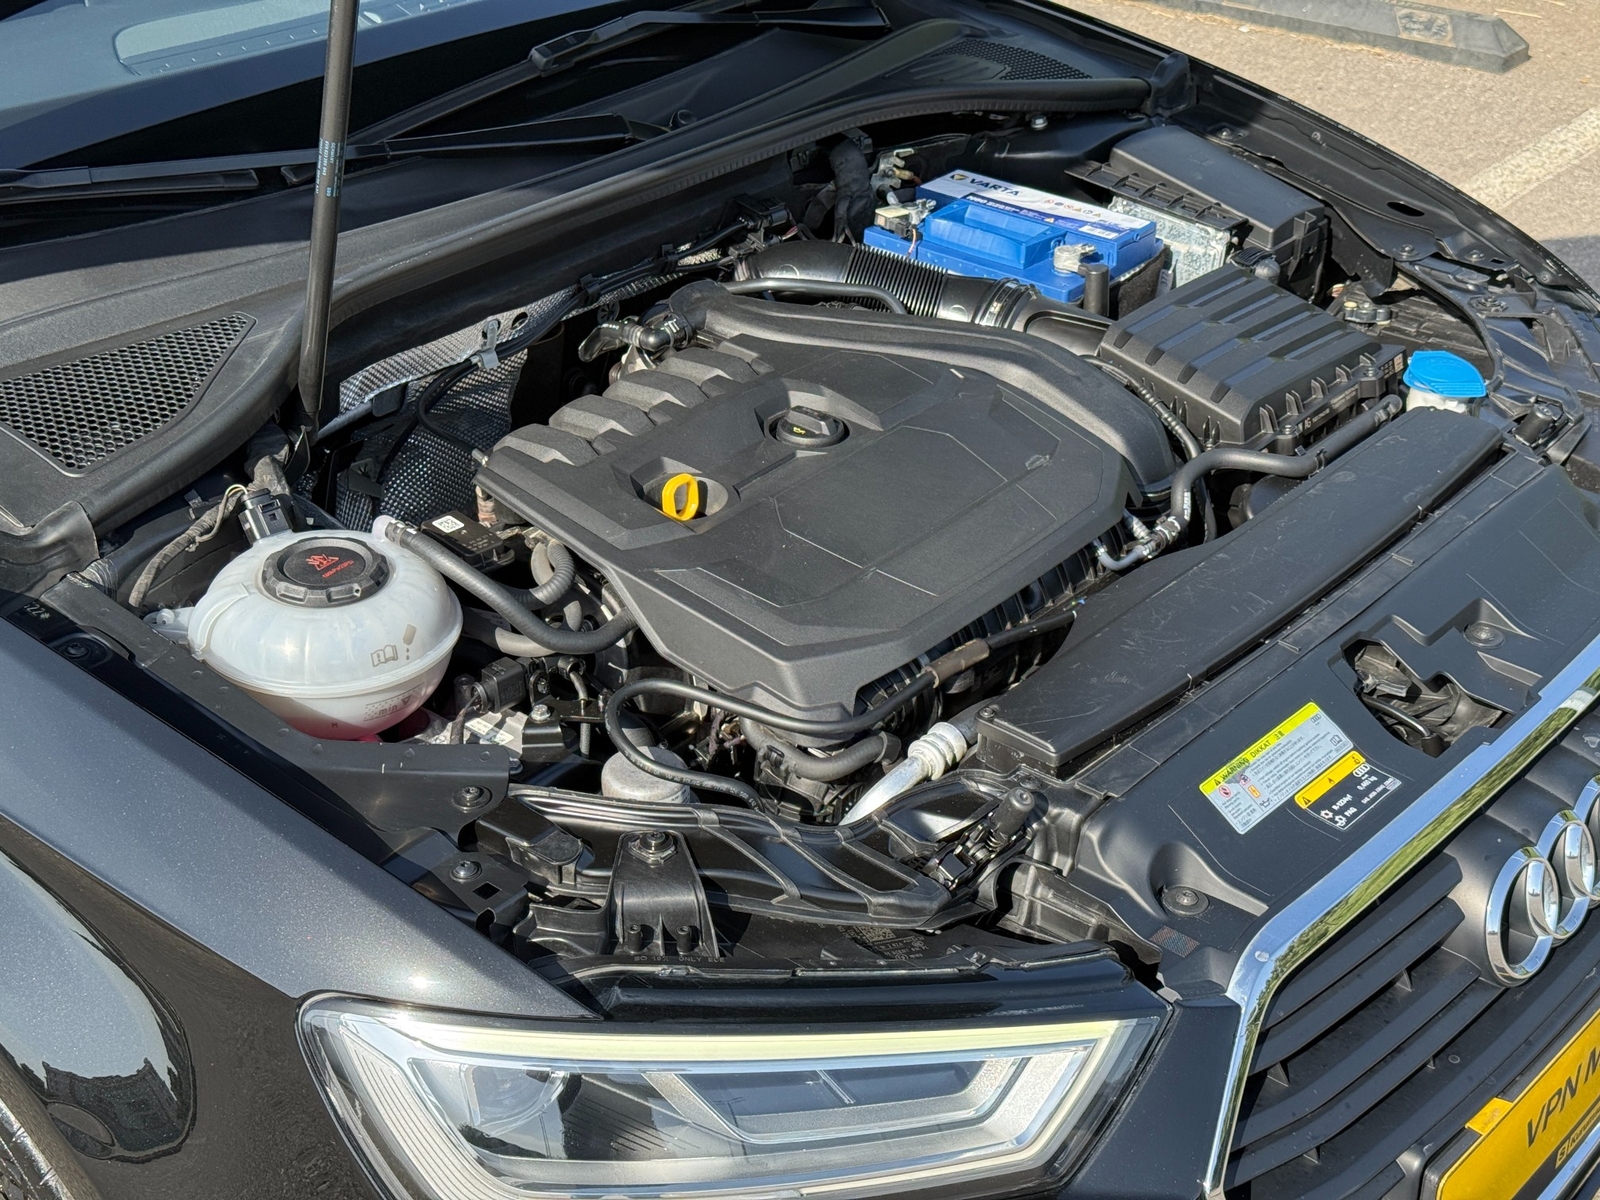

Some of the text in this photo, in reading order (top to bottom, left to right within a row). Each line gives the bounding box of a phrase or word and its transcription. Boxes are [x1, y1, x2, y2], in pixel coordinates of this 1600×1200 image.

[969, 178, 1020, 197] VARTA
[379, 703, 398, 716] min
[1221, 757, 1250, 780] WARNING
[1250, 740, 1271, 758] DIKKAT
[1527, 1062, 1582, 1149] VPN
